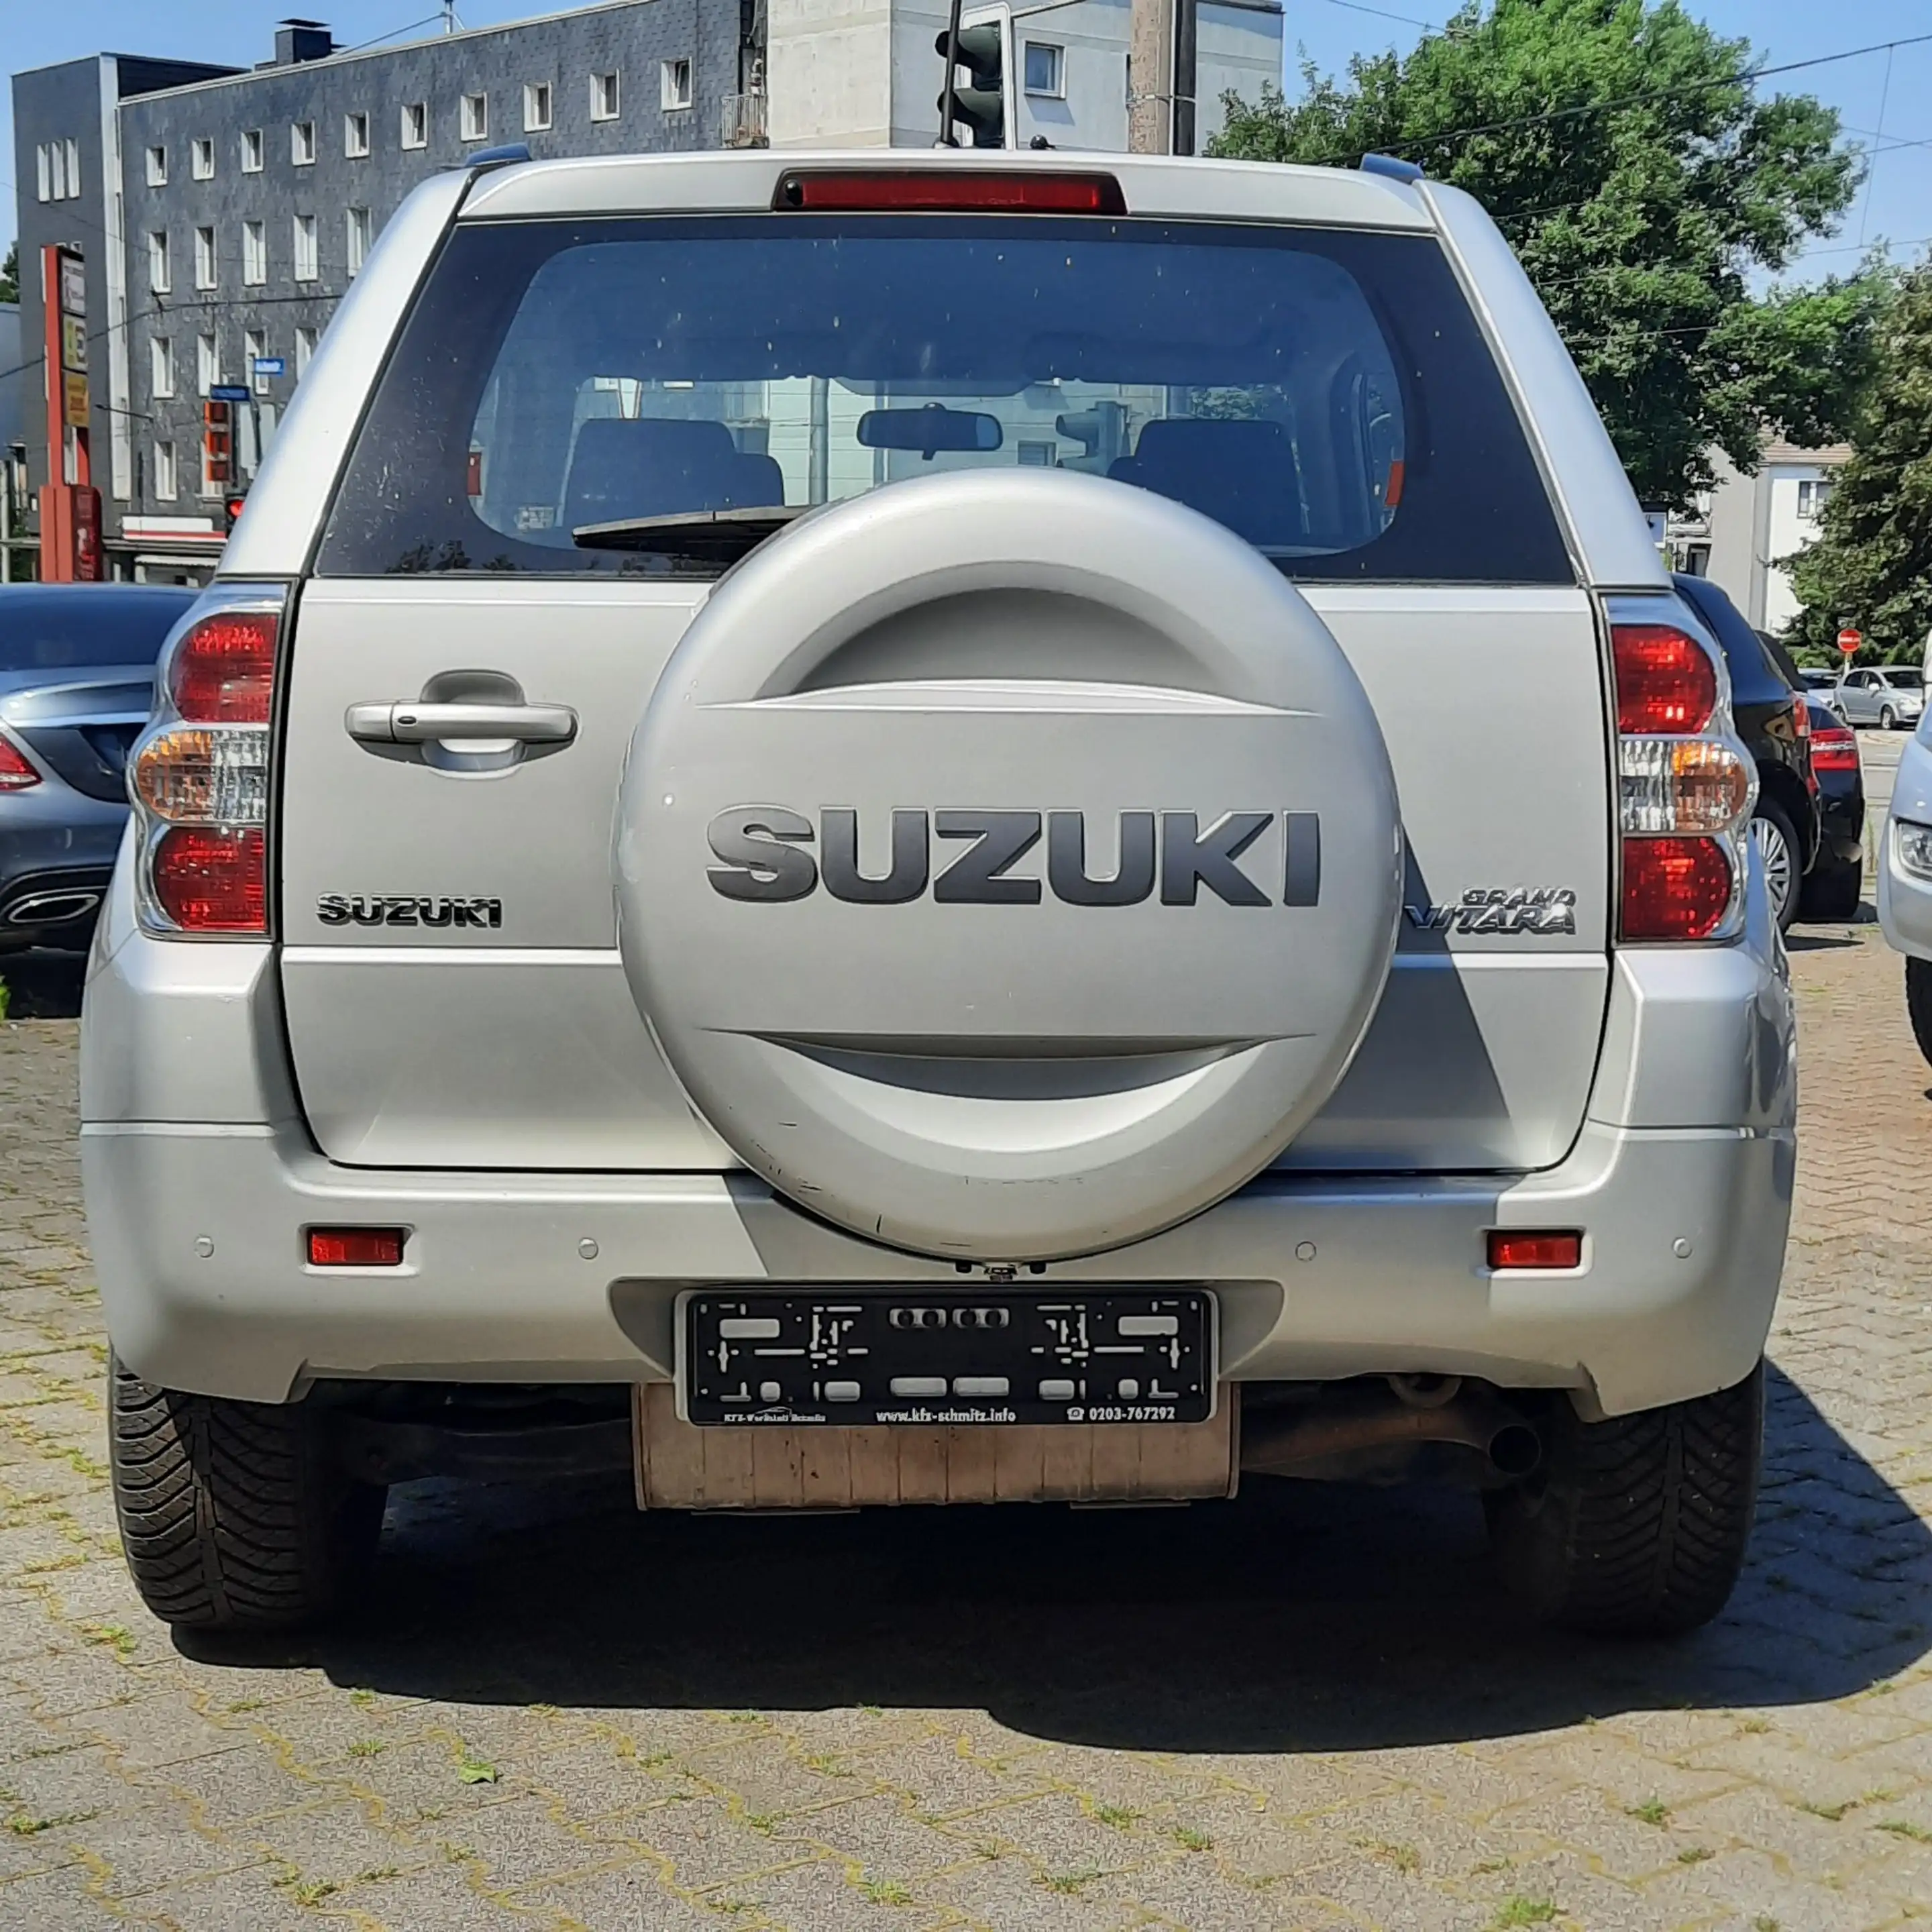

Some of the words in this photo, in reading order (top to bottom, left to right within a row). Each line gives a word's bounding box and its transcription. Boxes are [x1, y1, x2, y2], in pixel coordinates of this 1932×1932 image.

[706, 803, 1321, 907] SUZUKI
[316, 892, 502, 928] SUZUKI
[1462, 887, 1576, 908] GRAND
[1405, 904, 1576, 935] VITARA
[876, 1407, 1016, 1422] www.kfz-schmitz.info
[1089, 1407, 1175, 1421] 0203-767292
